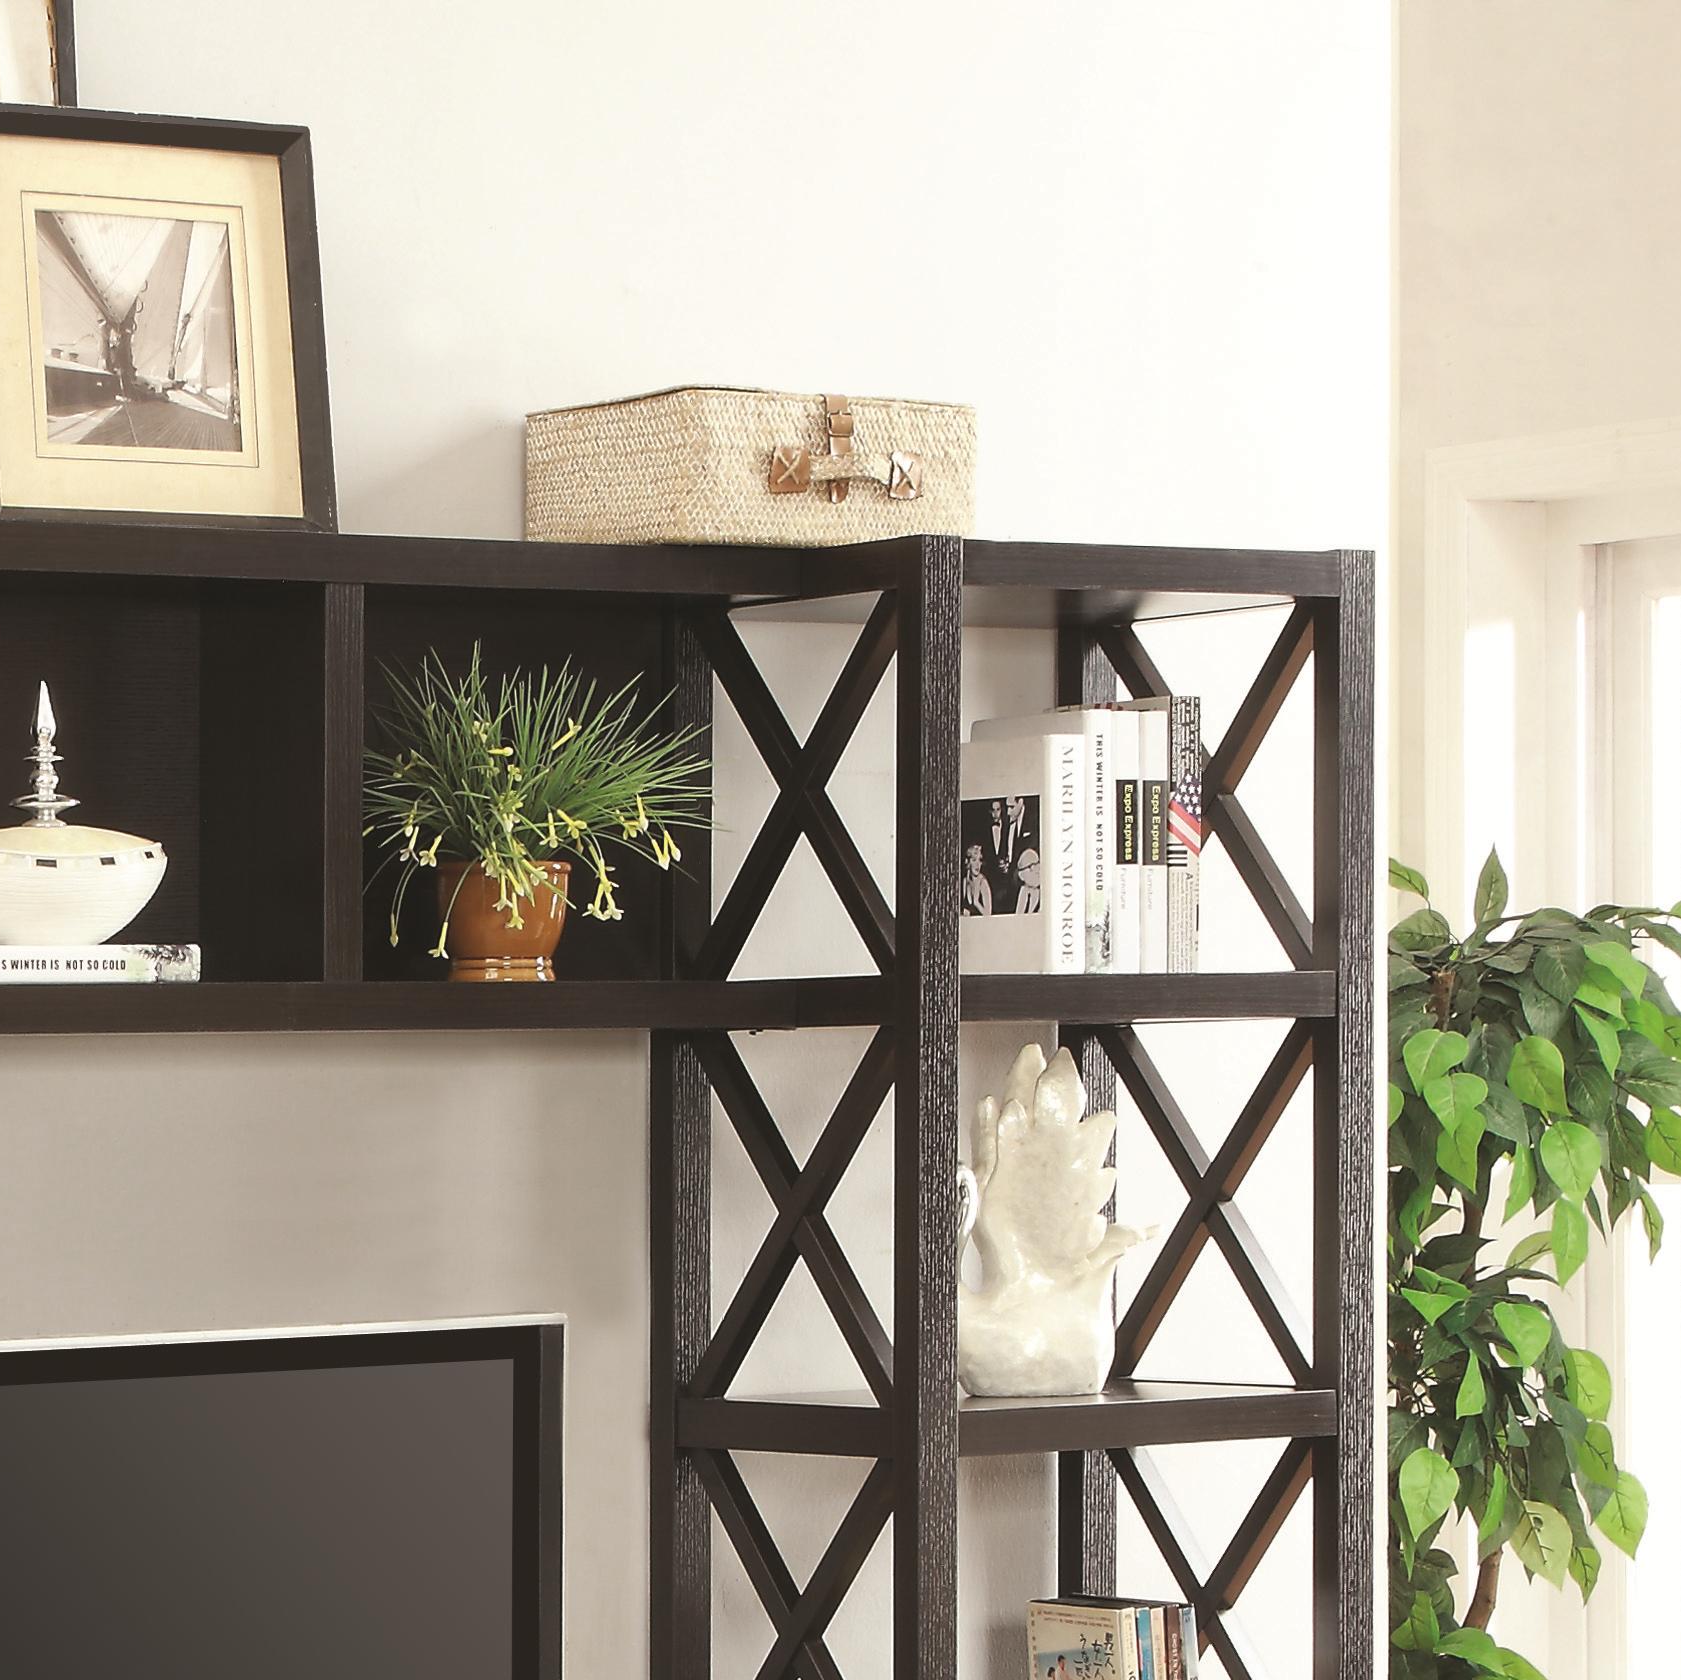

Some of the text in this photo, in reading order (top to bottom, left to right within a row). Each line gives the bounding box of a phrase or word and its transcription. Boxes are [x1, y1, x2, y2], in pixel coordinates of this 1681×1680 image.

[1096, 734, 1104, 891] THIS WINTER IS NOT SO COLD
[1124, 784, 1134, 861] Expo Express
[1151, 785, 1161, 861] Expo Express
[1062, 746, 1074, 964] MARILYN MONROE
[10, 959, 47, 970] WINTER
[50, 959, 60, 970] IS
[65, 959, 83, 970] NOT
[87, 959, 99, 970] SO
[102, 959, 126, 970] COLD
